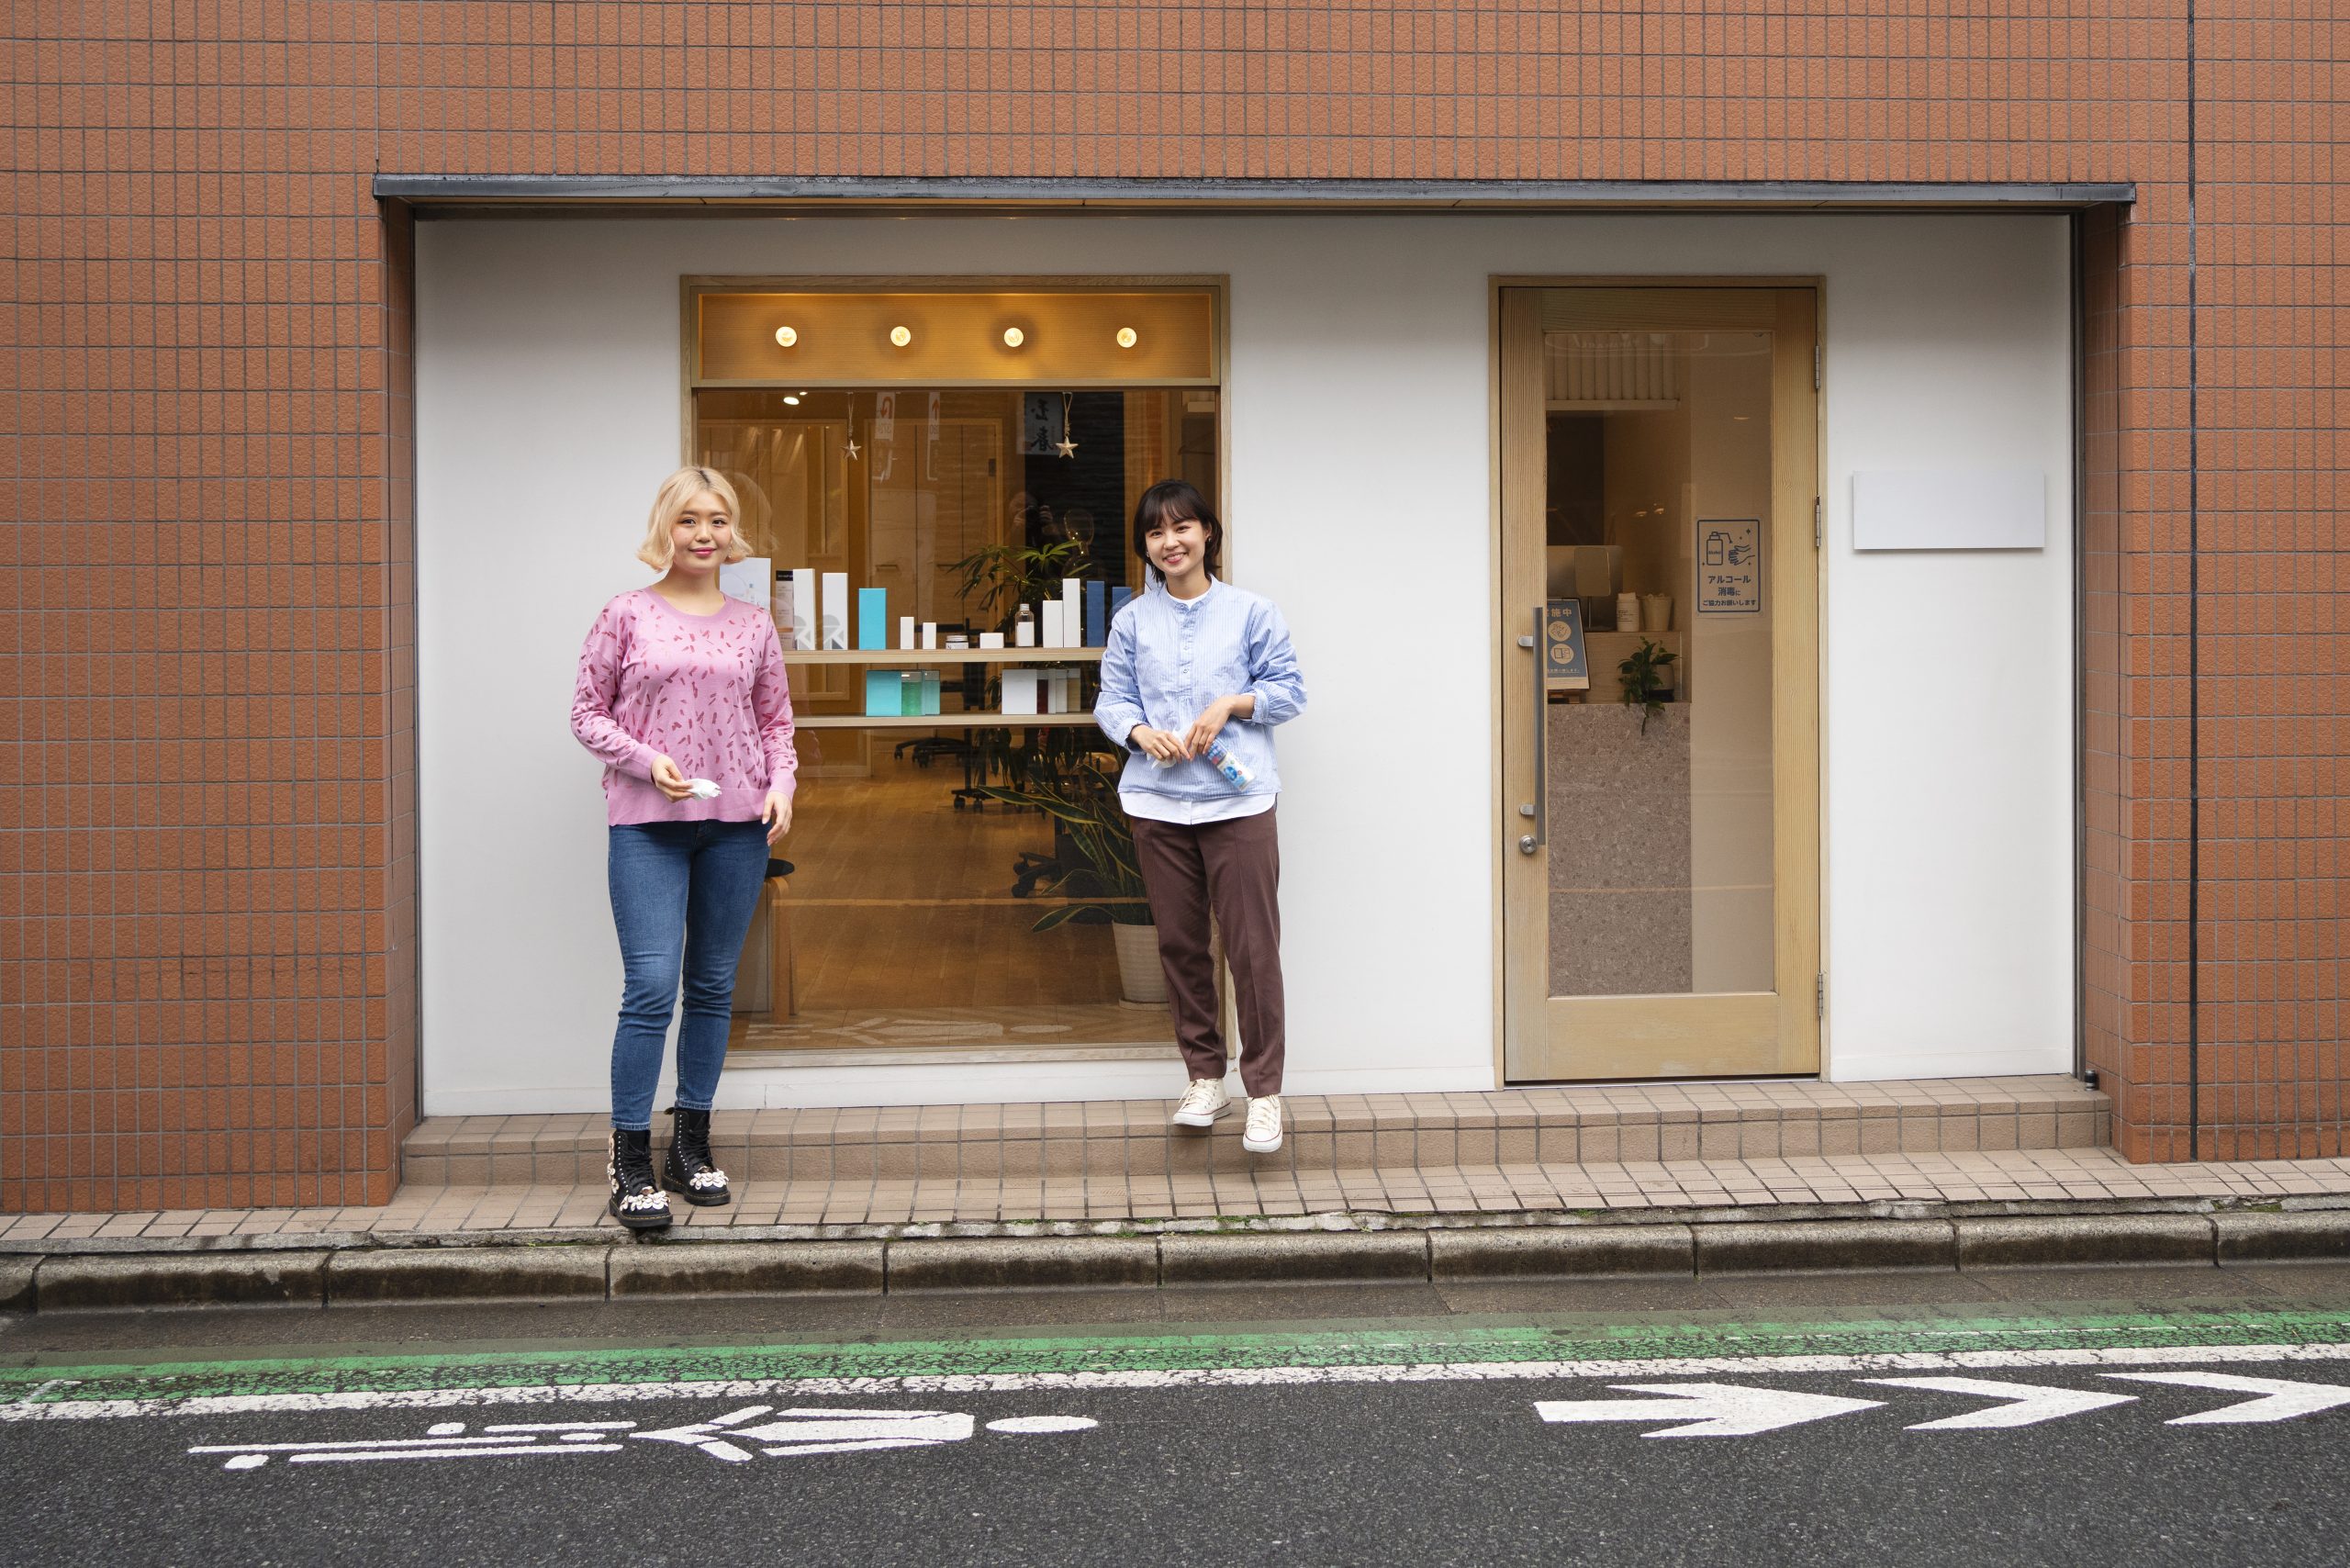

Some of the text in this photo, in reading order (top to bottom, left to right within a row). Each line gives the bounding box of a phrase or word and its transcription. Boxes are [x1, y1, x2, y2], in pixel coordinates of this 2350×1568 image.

[1707, 575, 1751, 585] アルコール
[1718, 587, 1741, 597] 消毒に
[1547, 608, 1572, 618] 施中
